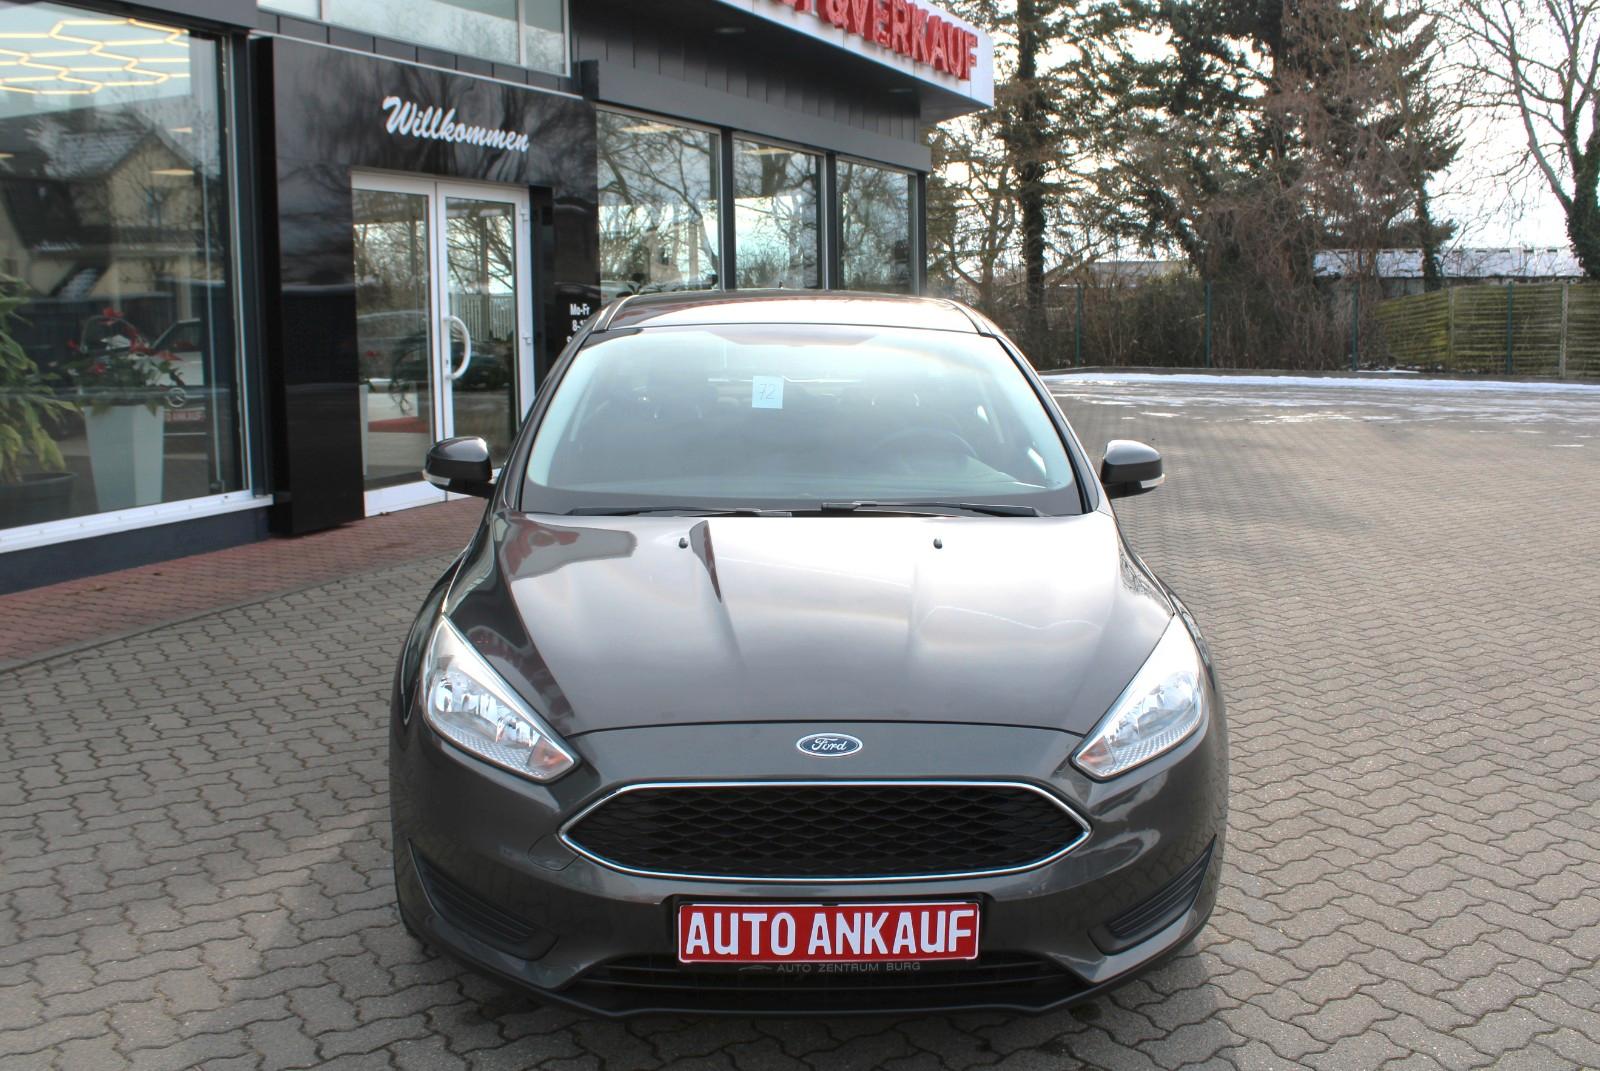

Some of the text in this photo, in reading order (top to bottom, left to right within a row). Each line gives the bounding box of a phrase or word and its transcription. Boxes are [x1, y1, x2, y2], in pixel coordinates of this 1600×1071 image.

[382, 96, 530, 152] Willkommen
[570, 303, 590, 316] Mo-Fr
[759, 383, 777, 400] 72
[811, 737, 848, 751] Ford
[685, 909, 975, 956] AUTO ANKAUF
[776, 962, 921, 973] AUTO ZENTRUM BURG
